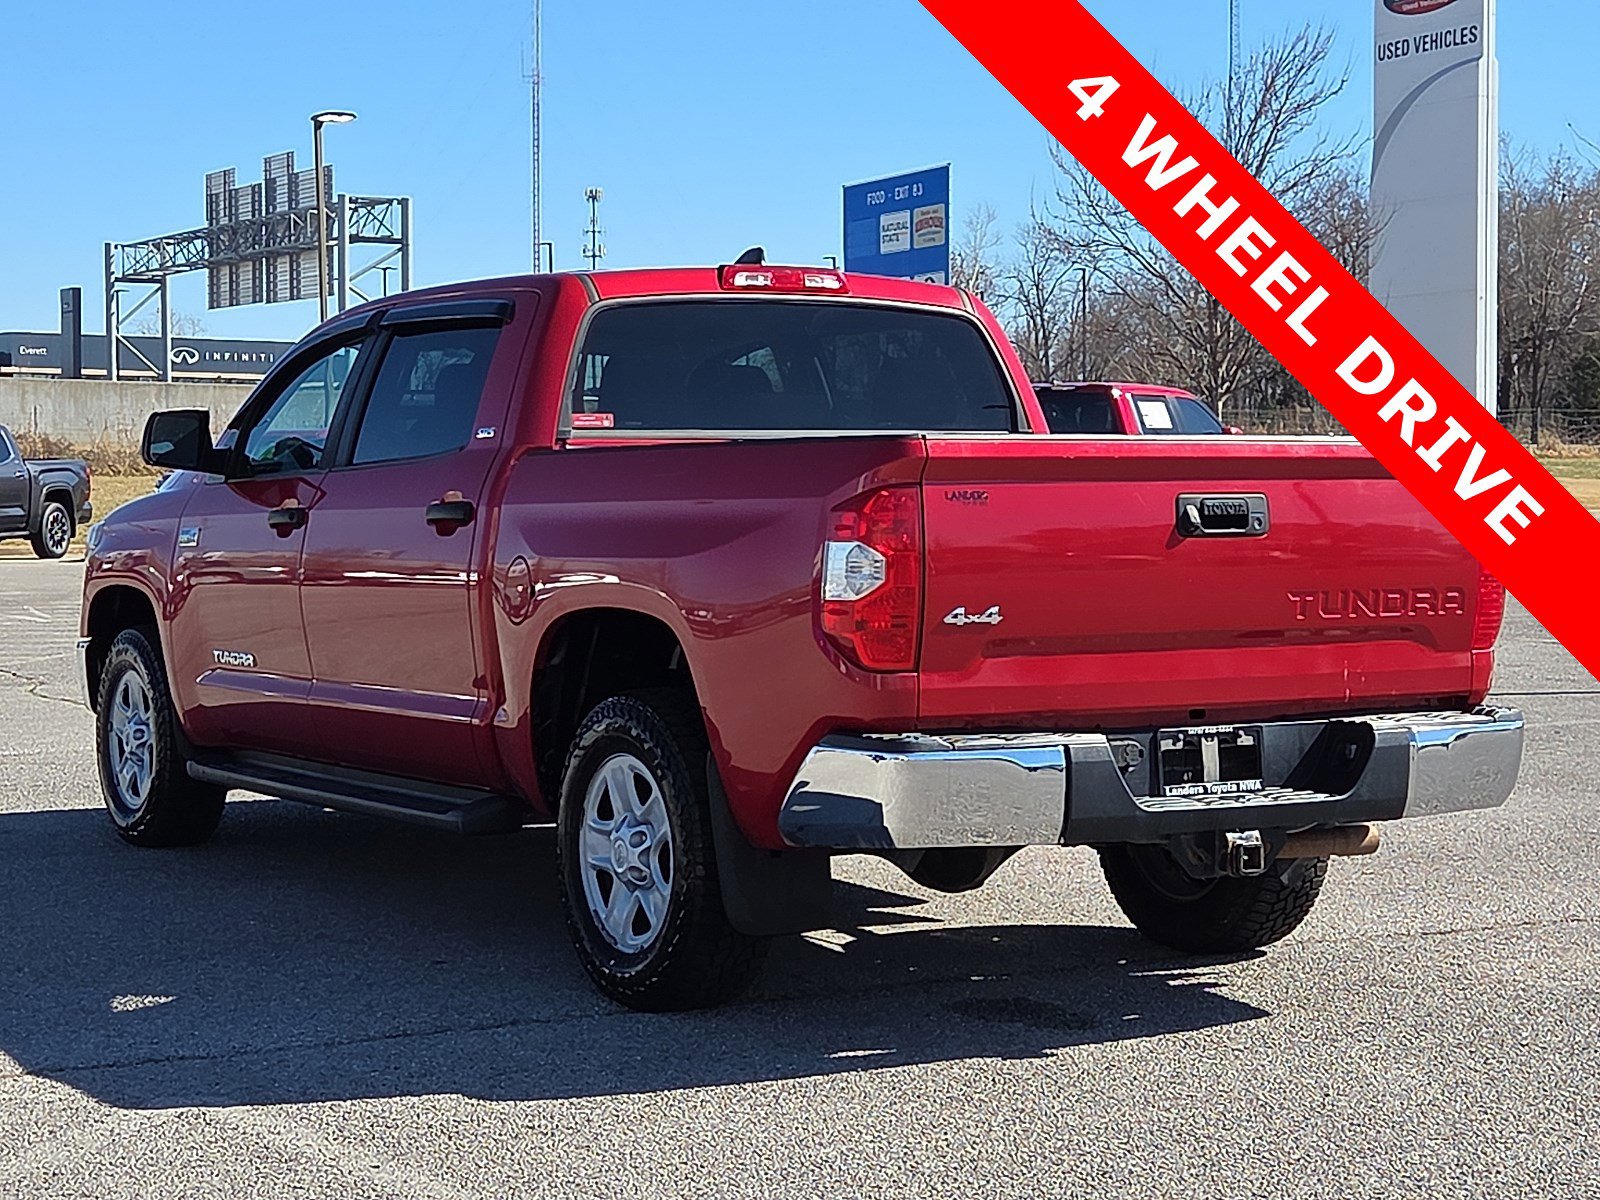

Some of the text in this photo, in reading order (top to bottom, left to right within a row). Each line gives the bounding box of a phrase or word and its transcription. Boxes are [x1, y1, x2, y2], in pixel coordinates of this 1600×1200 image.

[1377, 25, 1478, 62] USED VEHICLES
[866, 190, 886, 206] FOOD
[894, 185, 909, 200] EXIT
[19, 346, 48, 356] Everett
[205, 351, 275, 363] INFINITI
[1204, 502, 1248, 516] TOYOTA
[1287, 586, 1466, 620] TUNDRA
[943, 605, 1004, 626] 4x4
[212, 650, 256, 667] TUNDRA
[1165, 780, 1262, 797] Landers Toyota NWA
